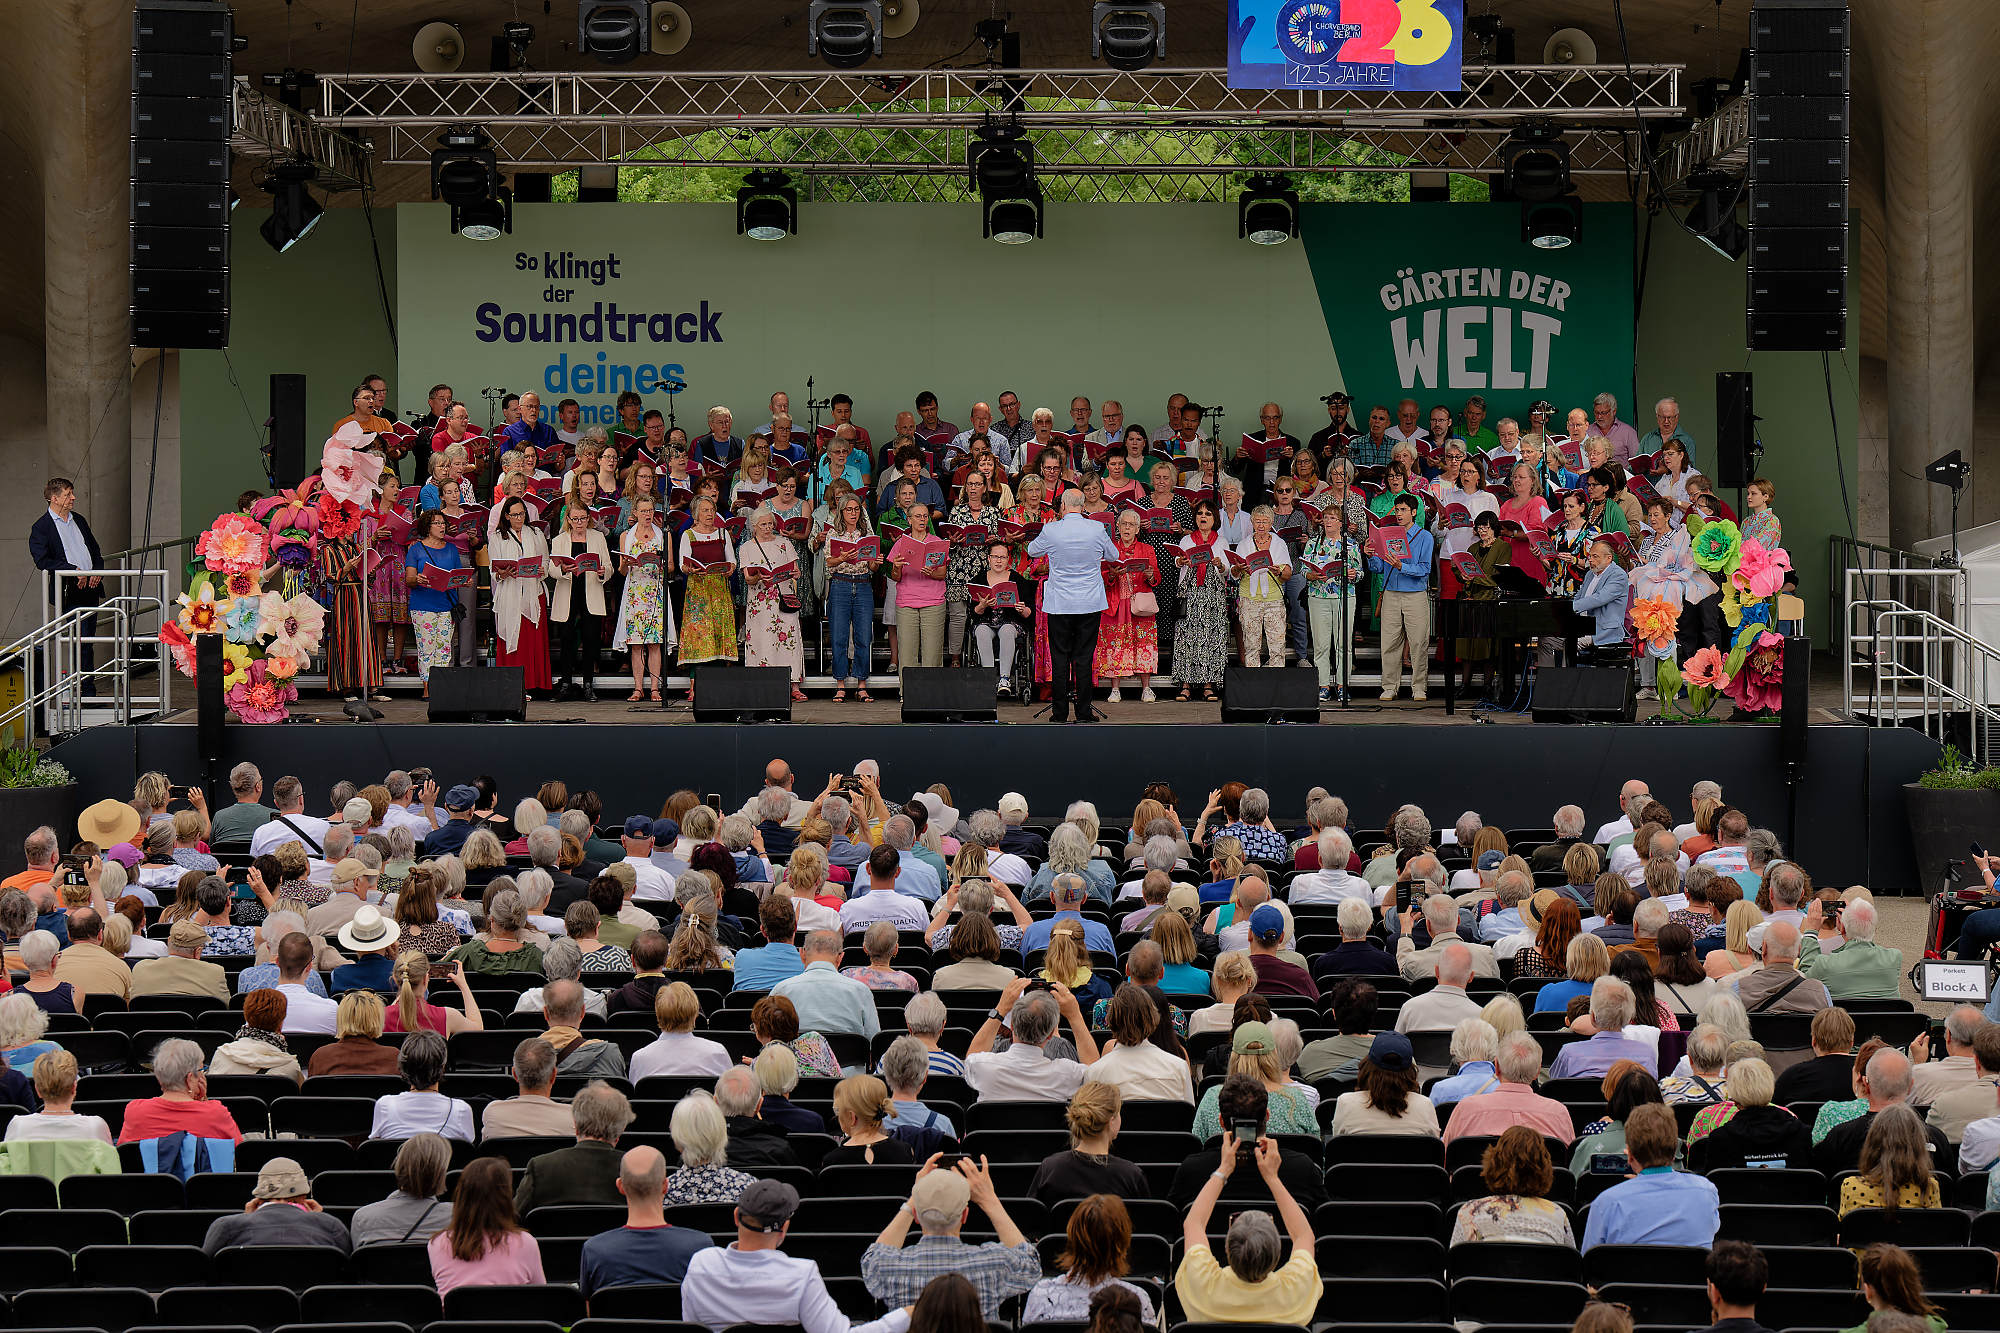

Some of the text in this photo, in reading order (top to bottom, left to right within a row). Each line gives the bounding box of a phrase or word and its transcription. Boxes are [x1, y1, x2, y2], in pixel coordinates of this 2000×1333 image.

[1333, 30, 1361, 39] BERLIN
[1289, 64, 1390, 85] 125 JAHRE
[515, 252, 621, 286] So klingt
[543, 285, 575, 303] der
[1379, 267, 1572, 312] GÄRTEN DER
[475, 300, 724, 343] Soundtrack
[1390, 305, 1562, 389] WELT
[544, 351, 685, 394] deines
[1932, 982, 1979, 992] Block A
